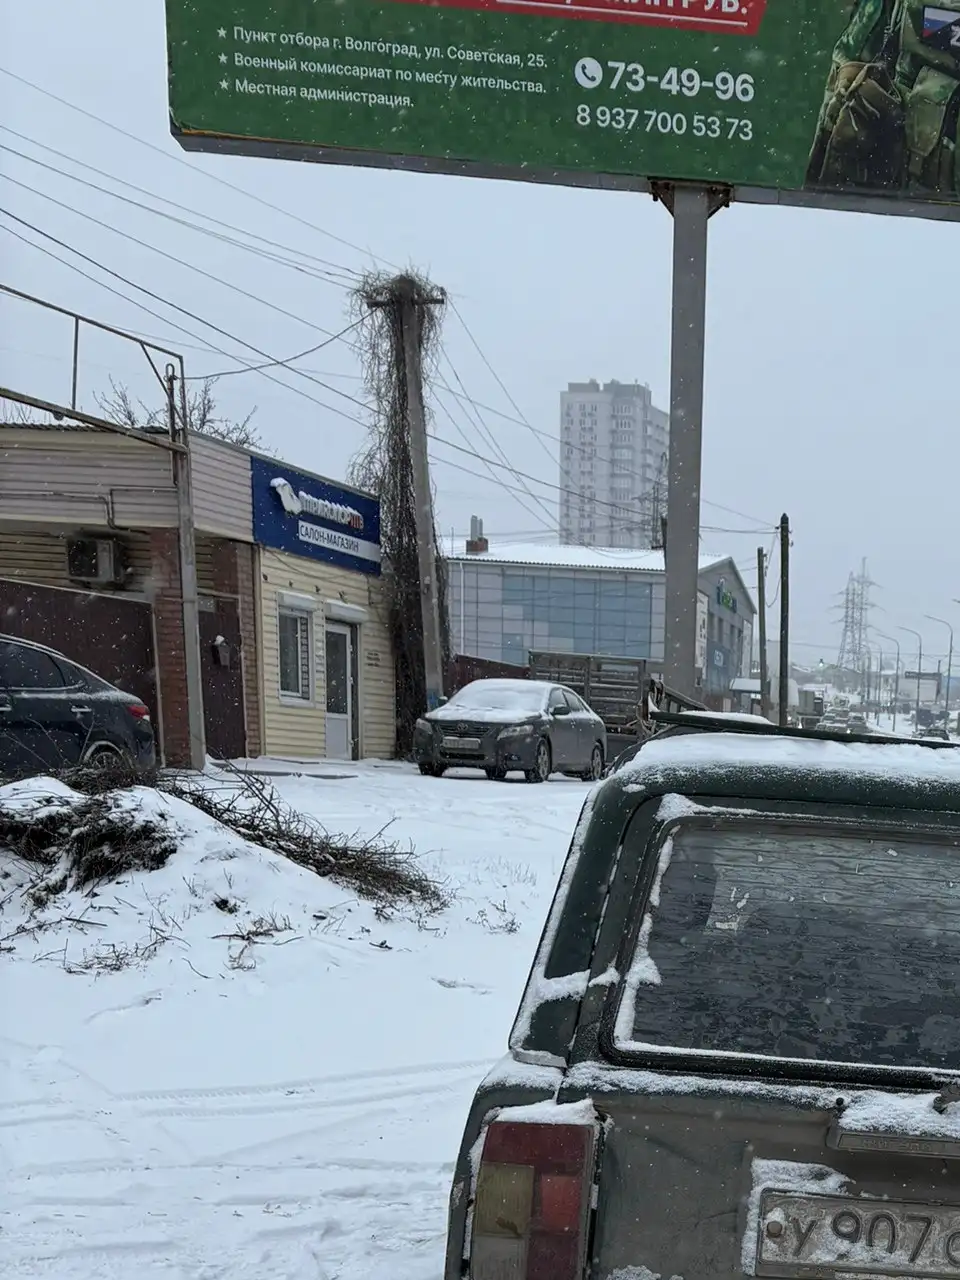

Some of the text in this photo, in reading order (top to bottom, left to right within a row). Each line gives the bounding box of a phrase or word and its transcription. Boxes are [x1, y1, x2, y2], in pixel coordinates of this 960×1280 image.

[233, 26, 548, 69] Пункт отбора г. Волгоград, ул. Советская, 25.
[234, 52, 547, 94] Военный комиссариат по месту жительства.
[607, 60, 755, 102] 73-49-96
[235, 78, 414, 108] Местная администрация.
[576, 104, 753, 141] 8 937 700 53 73
[299, 524, 360, 553] САЛОН-МАГАЗИН
